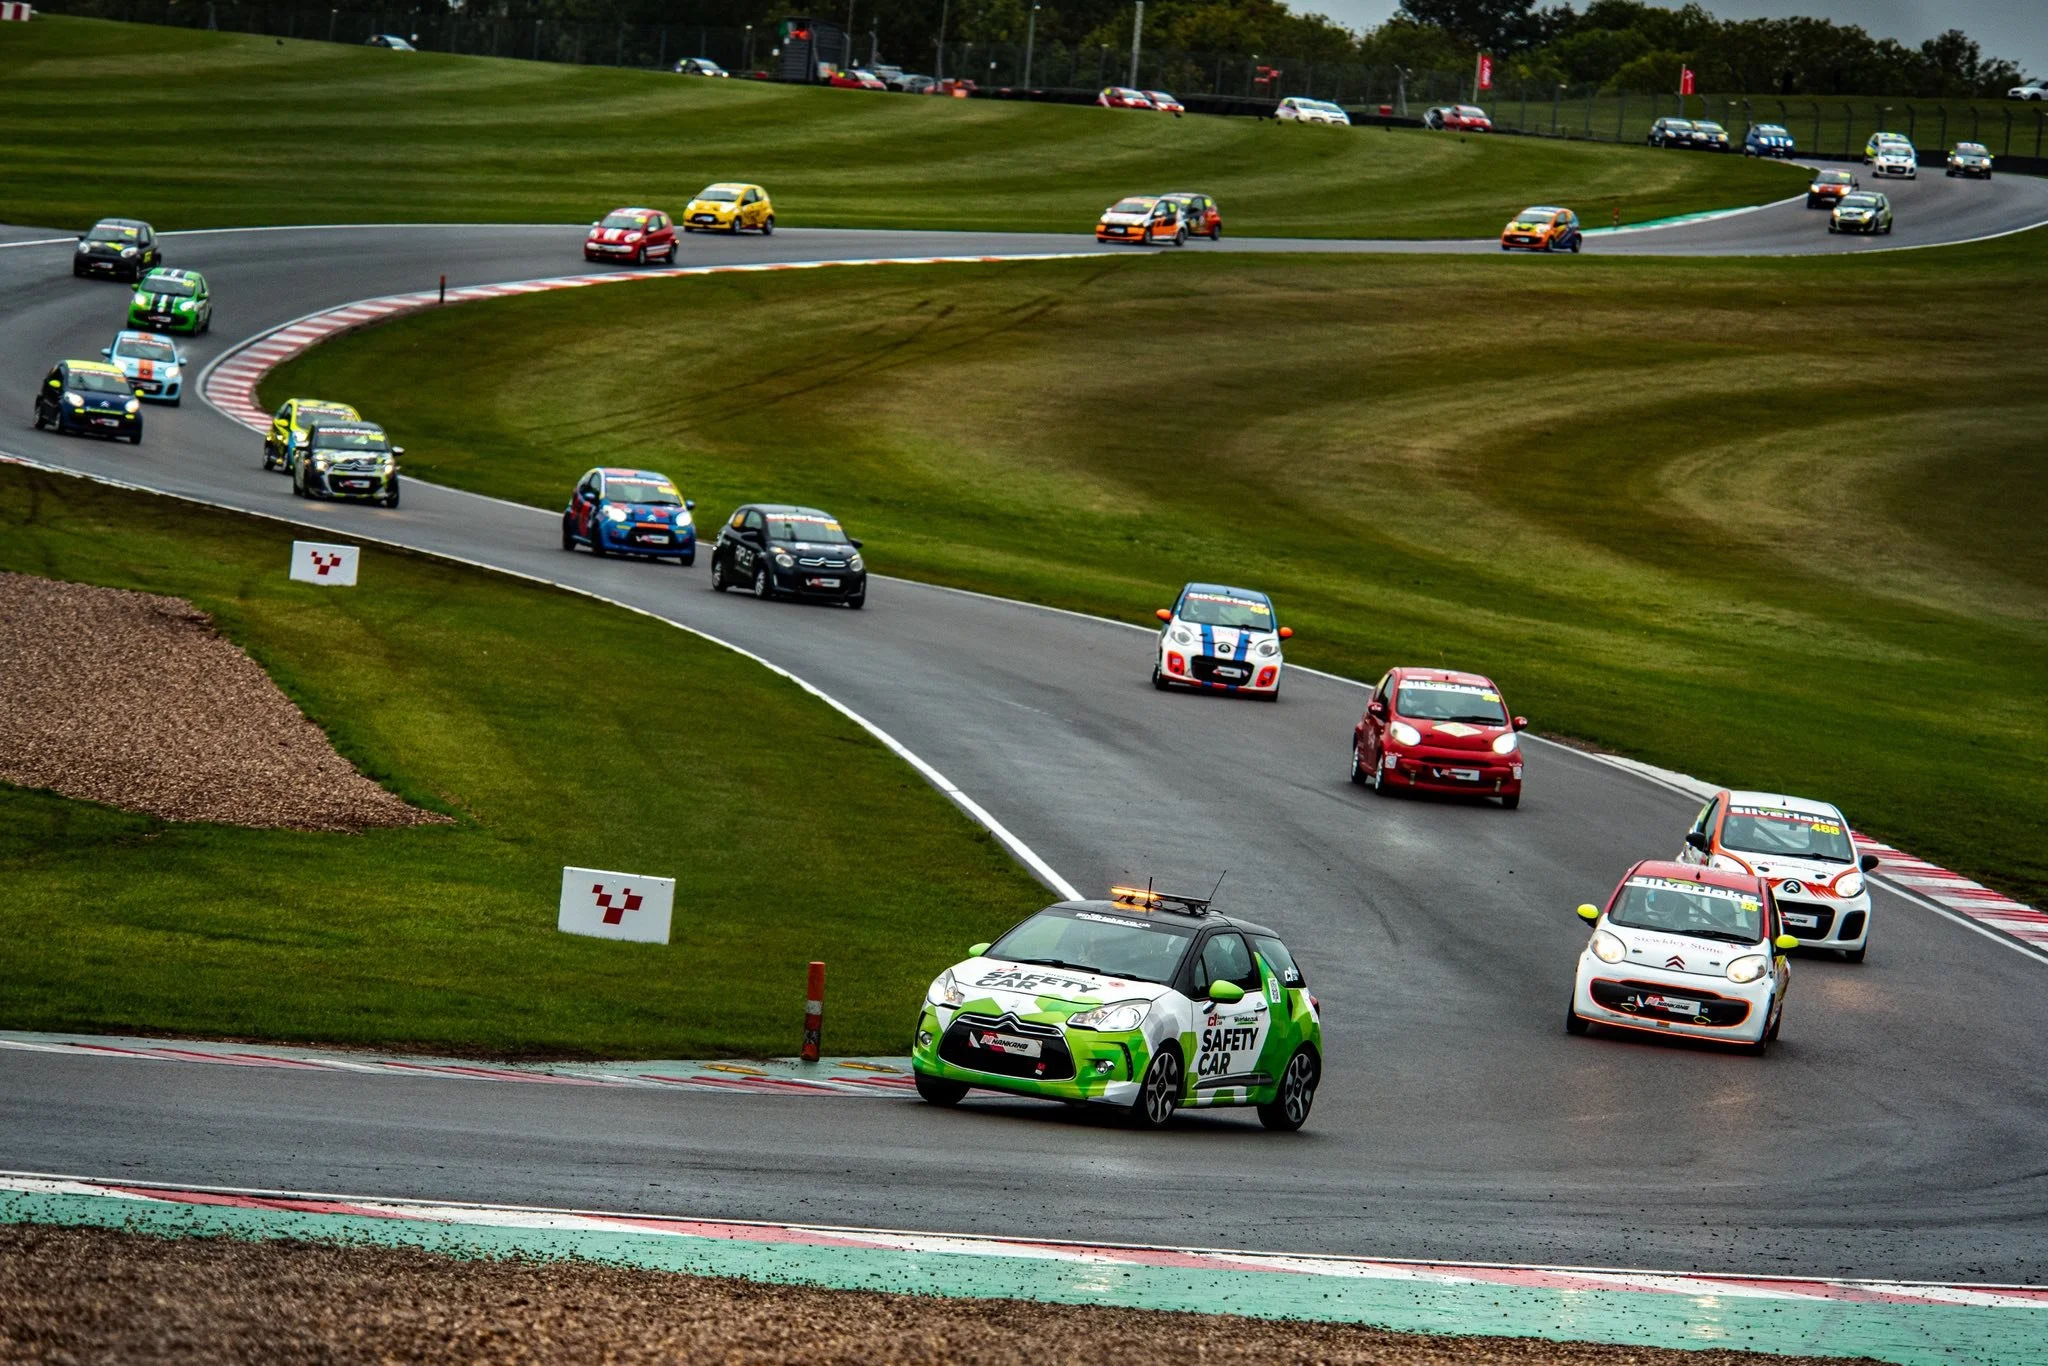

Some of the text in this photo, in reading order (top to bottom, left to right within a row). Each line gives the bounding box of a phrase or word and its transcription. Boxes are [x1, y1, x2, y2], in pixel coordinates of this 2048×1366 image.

[1731, 806, 1840, 827] Silverlake
[1632, 876, 1759, 902] Silverlake
[975, 978, 1038, 990] CAR
[983, 971, 1100, 993] SAFETY
[1201, 1027, 1259, 1052] SAFETY
[1198, 1052, 1231, 1076] CAR
